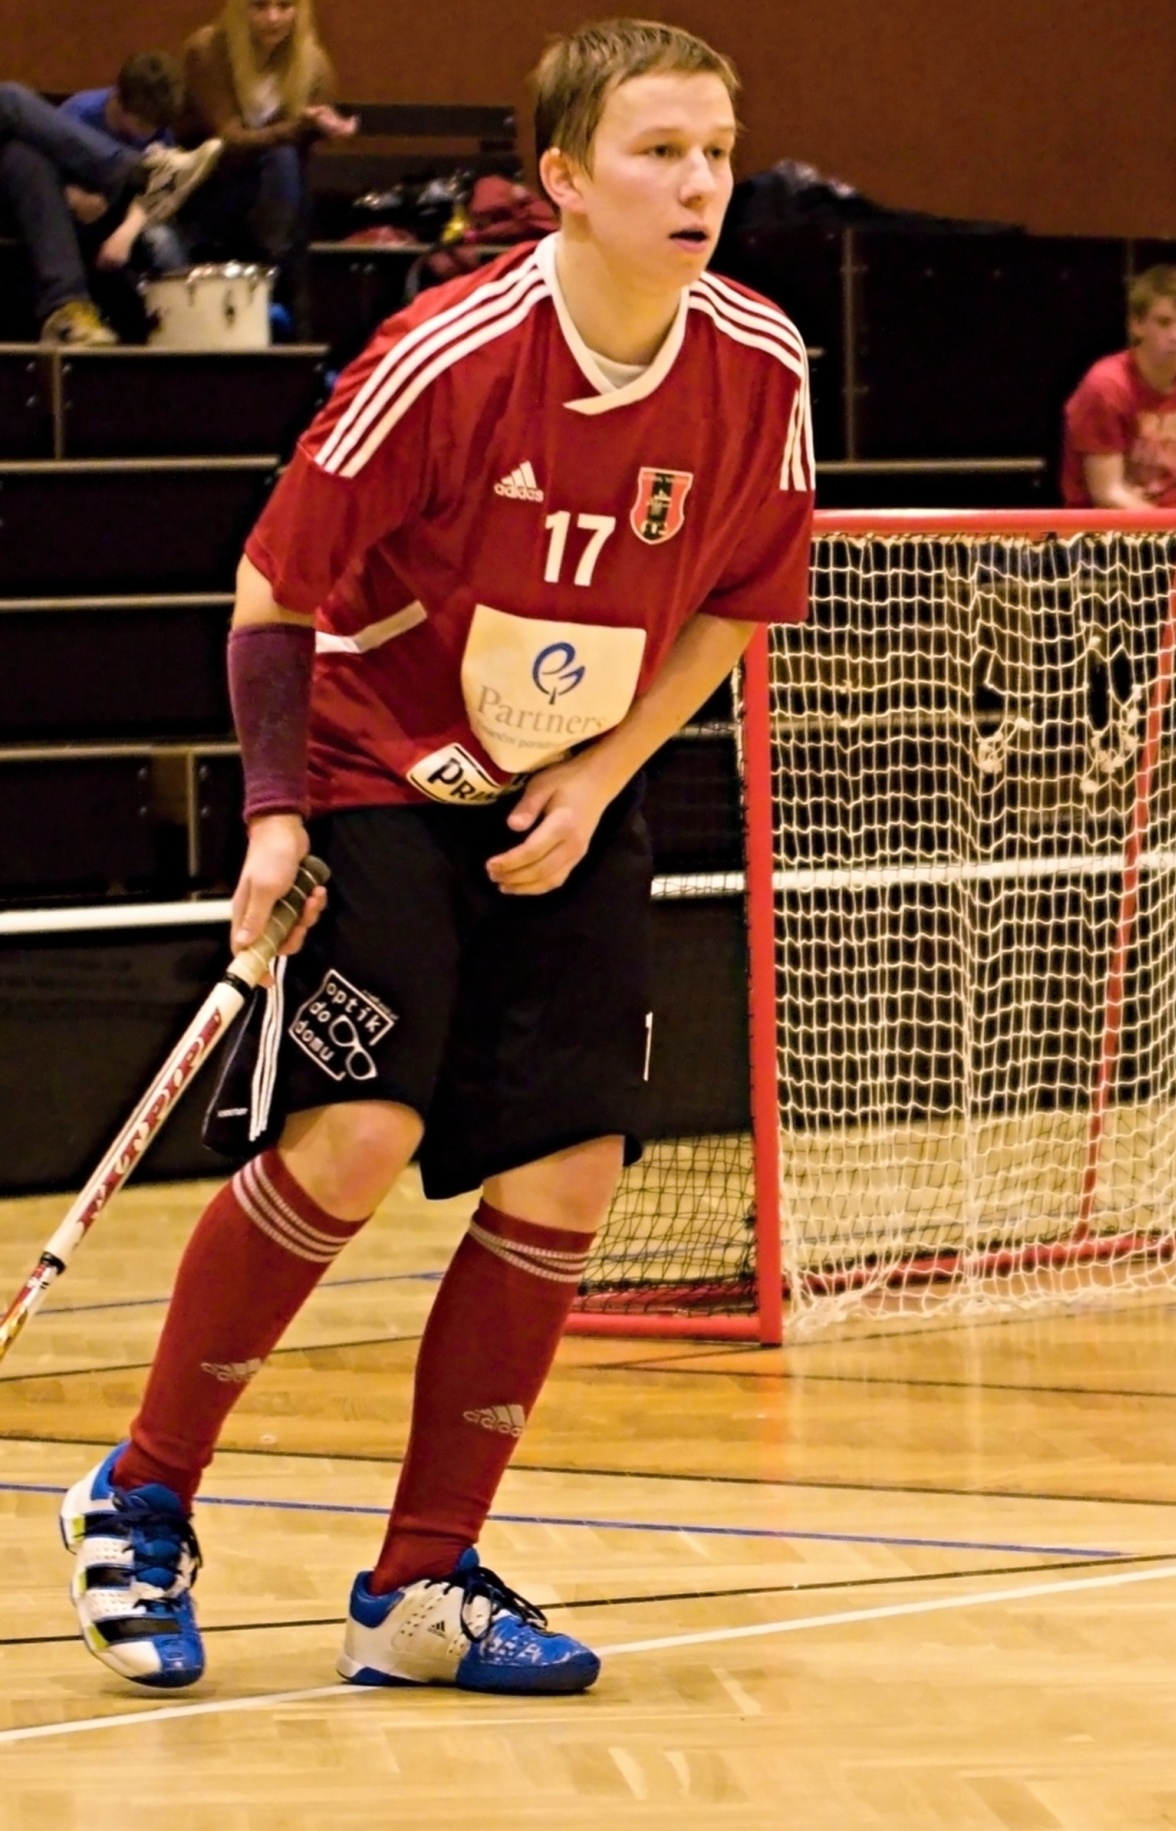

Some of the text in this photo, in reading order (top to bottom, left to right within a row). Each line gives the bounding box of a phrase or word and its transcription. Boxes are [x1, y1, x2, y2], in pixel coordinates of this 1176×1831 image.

[543, 509, 617, 588] 17
[476, 684, 607, 736] Partners
[309, 1001, 331, 1023] do
[325, 982, 382, 1034] optik
[294, 1019, 336, 1062] domu
